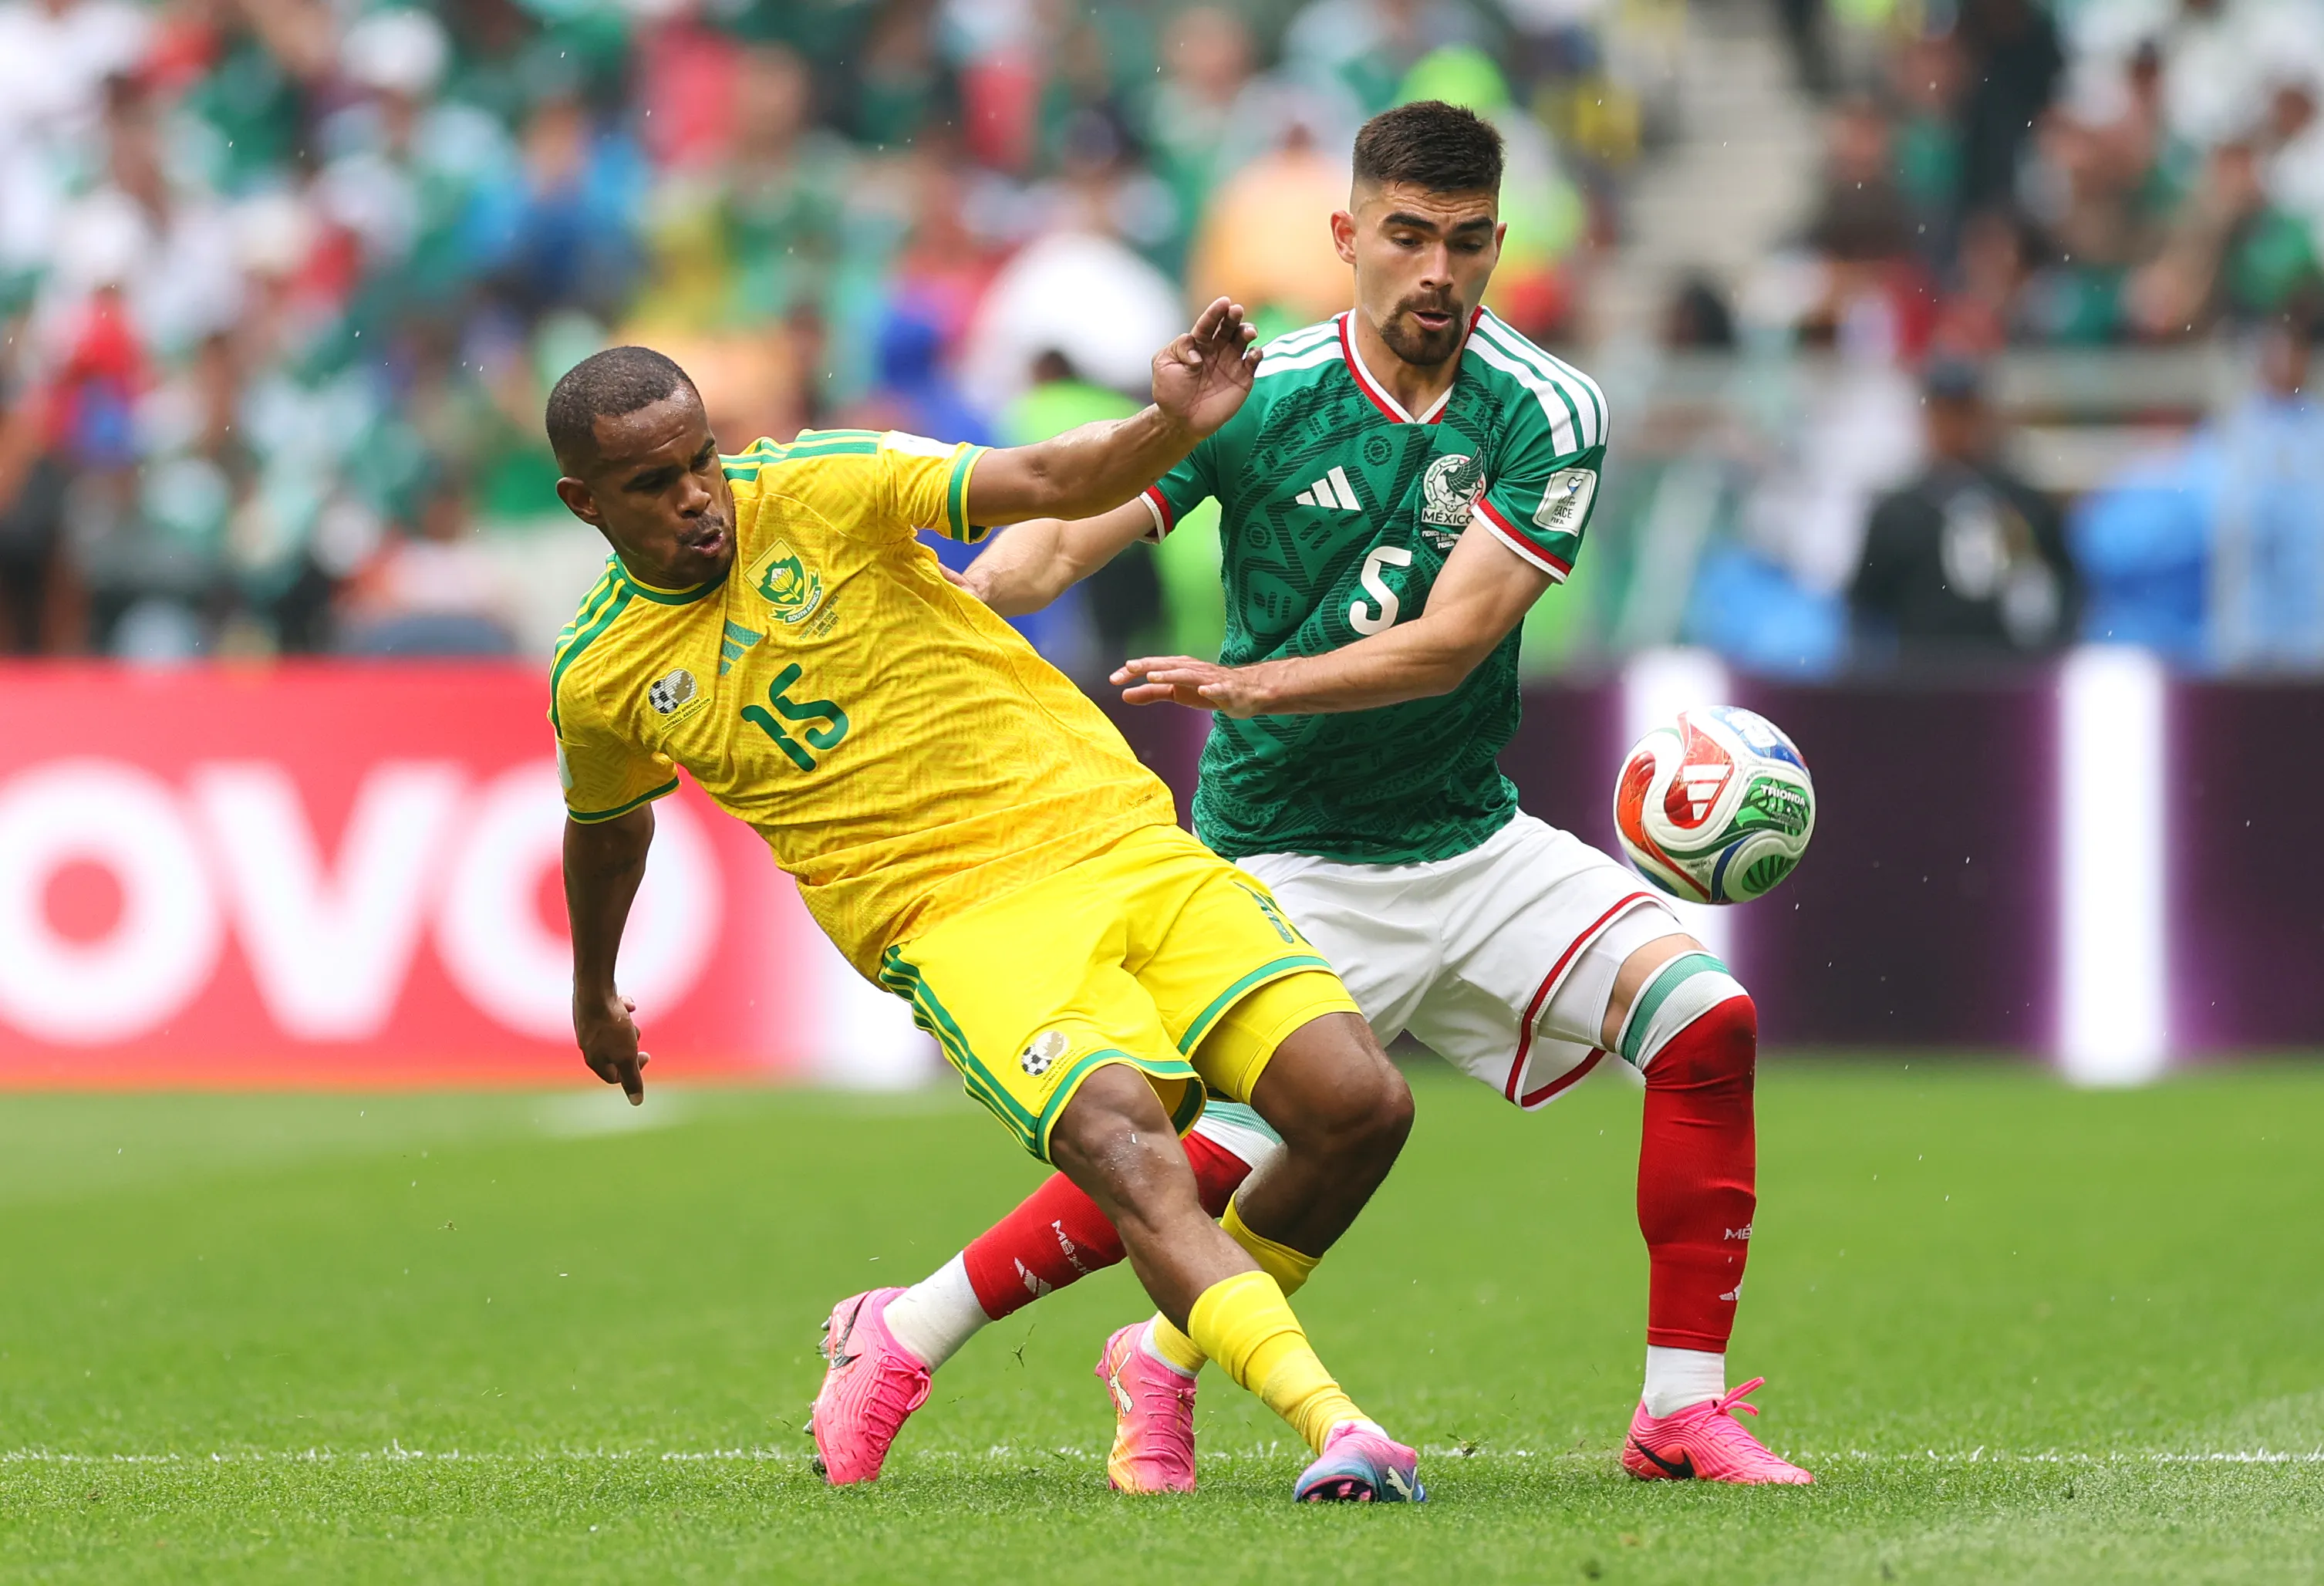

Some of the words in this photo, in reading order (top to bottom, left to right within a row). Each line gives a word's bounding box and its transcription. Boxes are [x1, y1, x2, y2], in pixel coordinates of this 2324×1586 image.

[788, 610, 808, 622] SOUTH
[806, 589, 821, 612] AFRICA
[1349, 545, 1413, 636] 5
[681, 699, 700, 712] AFRICAN
[740, 662, 849, 772] 15
[1760, 784, 1806, 808] TRIONDA
